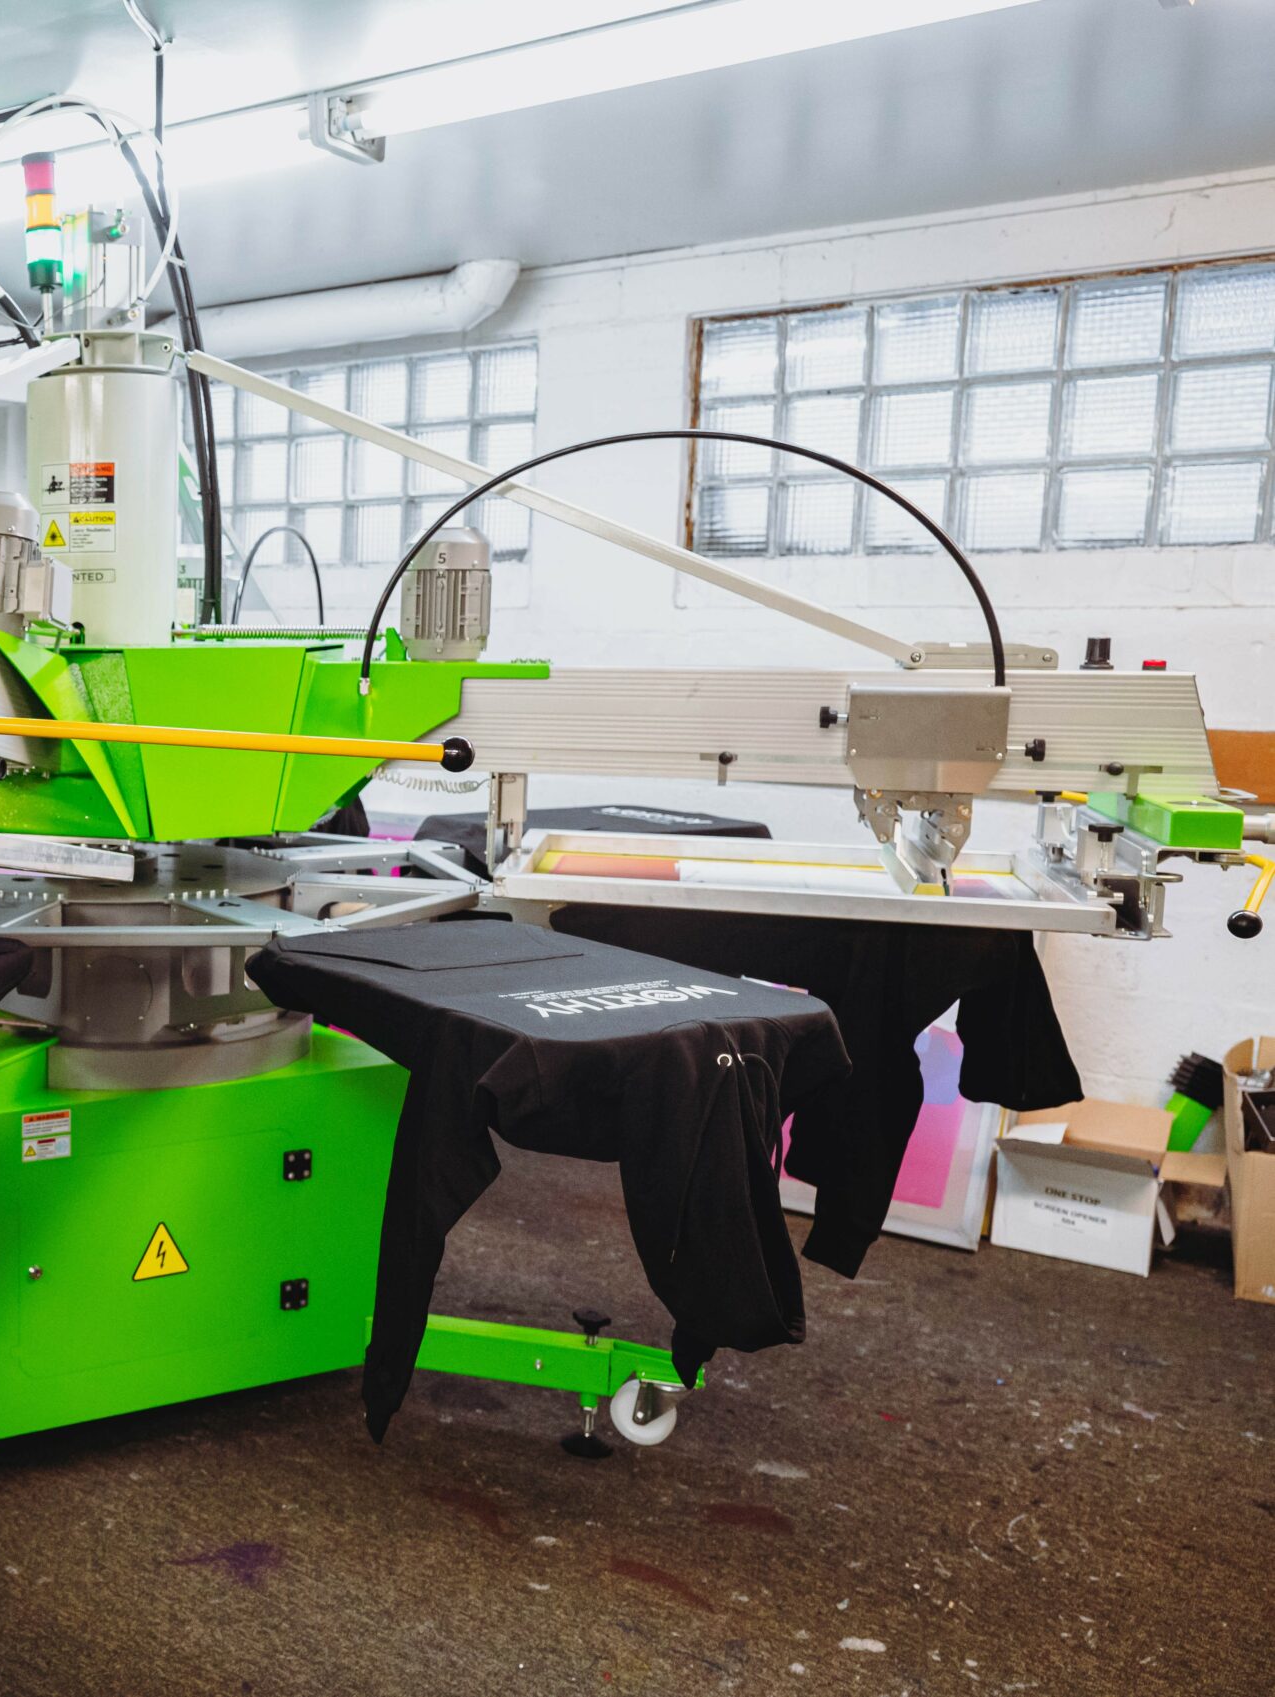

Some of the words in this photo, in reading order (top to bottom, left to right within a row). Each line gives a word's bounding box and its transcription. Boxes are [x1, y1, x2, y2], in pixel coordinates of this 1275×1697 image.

[438, 552, 447, 564] 5
[179, 564, 186, 574] 3
[524, 984, 739, 1018] WORTHY
[1071, 1193, 1102, 1206] STOP
